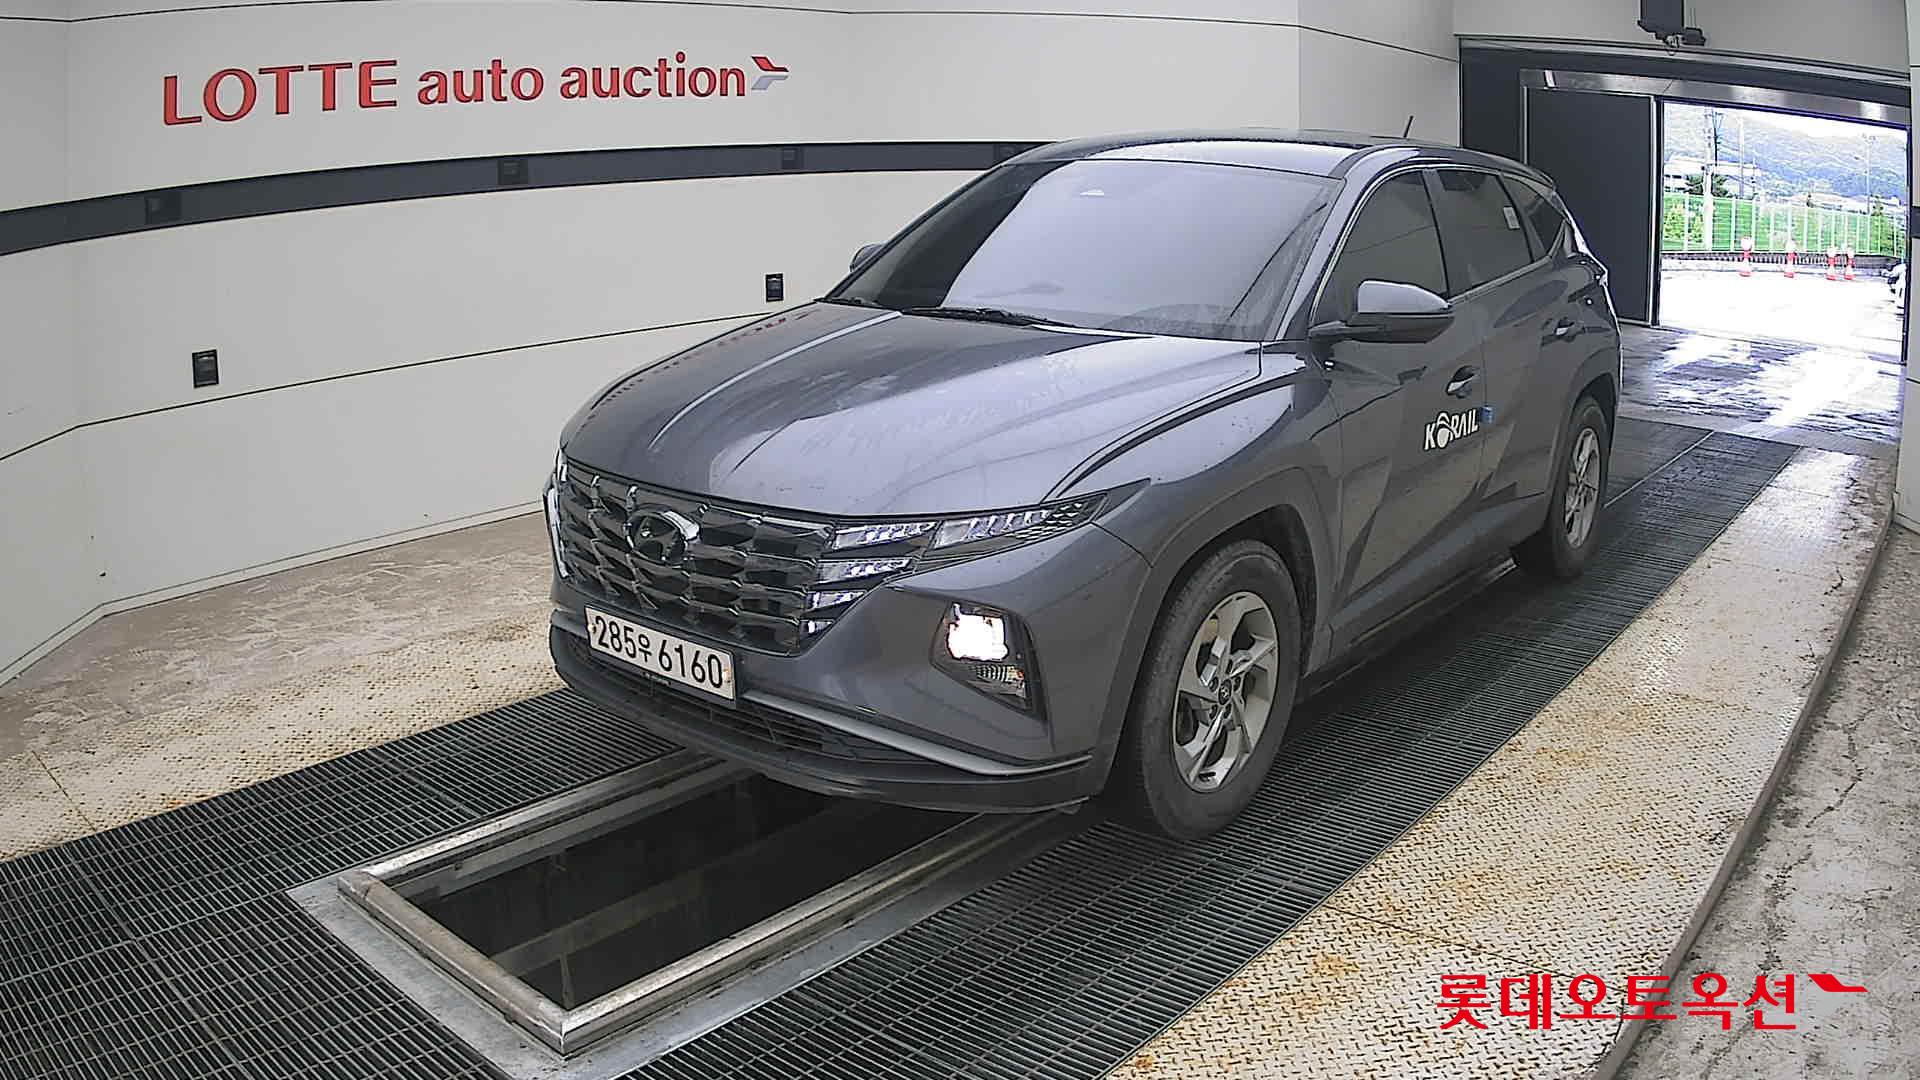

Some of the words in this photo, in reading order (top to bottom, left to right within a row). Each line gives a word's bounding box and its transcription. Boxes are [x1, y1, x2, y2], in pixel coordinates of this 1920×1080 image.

[163, 58, 398, 126] LOTTE
[417, 58, 545, 105] auto
[559, 51, 747, 101] auction
[1423, 408, 1479, 451] KORAIL
[658, 639, 723, 689] 6160
